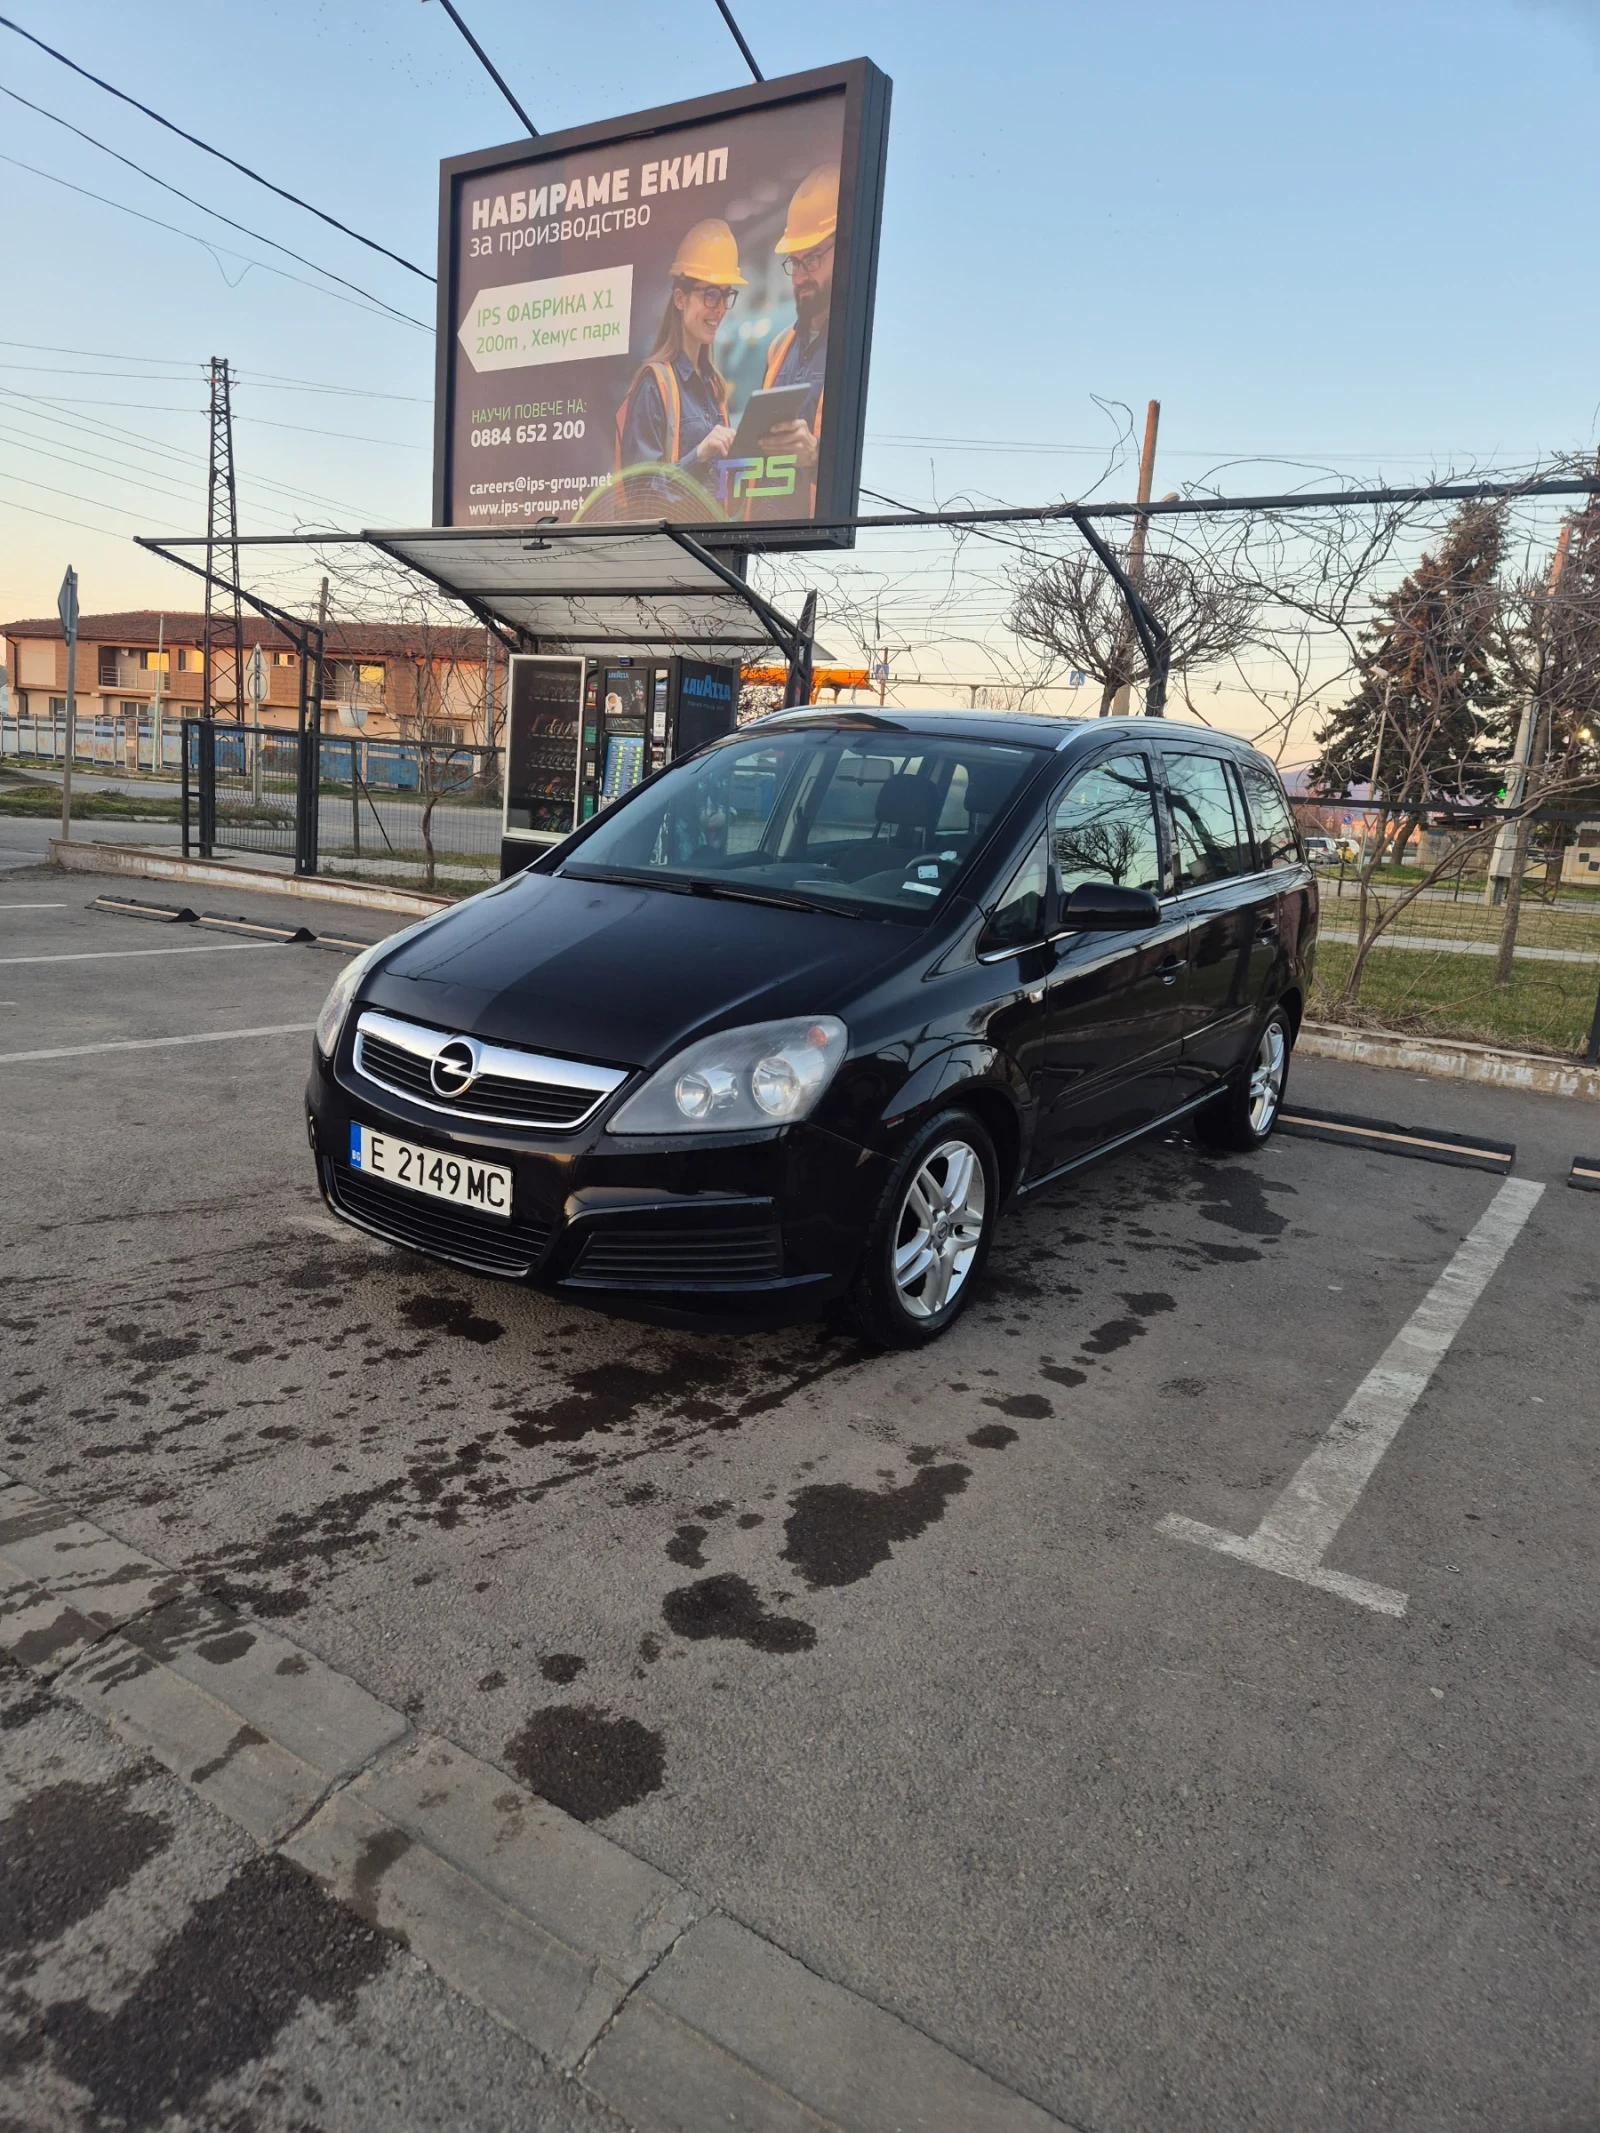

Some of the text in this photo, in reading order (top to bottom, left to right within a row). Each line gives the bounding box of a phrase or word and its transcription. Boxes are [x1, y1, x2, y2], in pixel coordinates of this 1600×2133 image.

[472, 147, 729, 230] НАБИРАМЕ ЕКИП
[470, 204, 651, 257] за производство
[477, 307, 501, 328] IPS
[507, 293, 587, 322] ФАБРИКА
[532, 327, 578, 347] Хемус
[582, 321, 621, 342] парк
[471, 398, 588, 424] НАУЧИ ПОВЕЧЕ НА:
[470, 419, 586, 448] 0884 652 200
[469, 472, 613, 495] careers@ips-group.net
[468, 496, 585, 517] www.ips-group.net
[683, 674, 731, 701] LAVAZZA
[352, 1150, 361, 1162] BG
[371, 1136, 385, 1172] E
